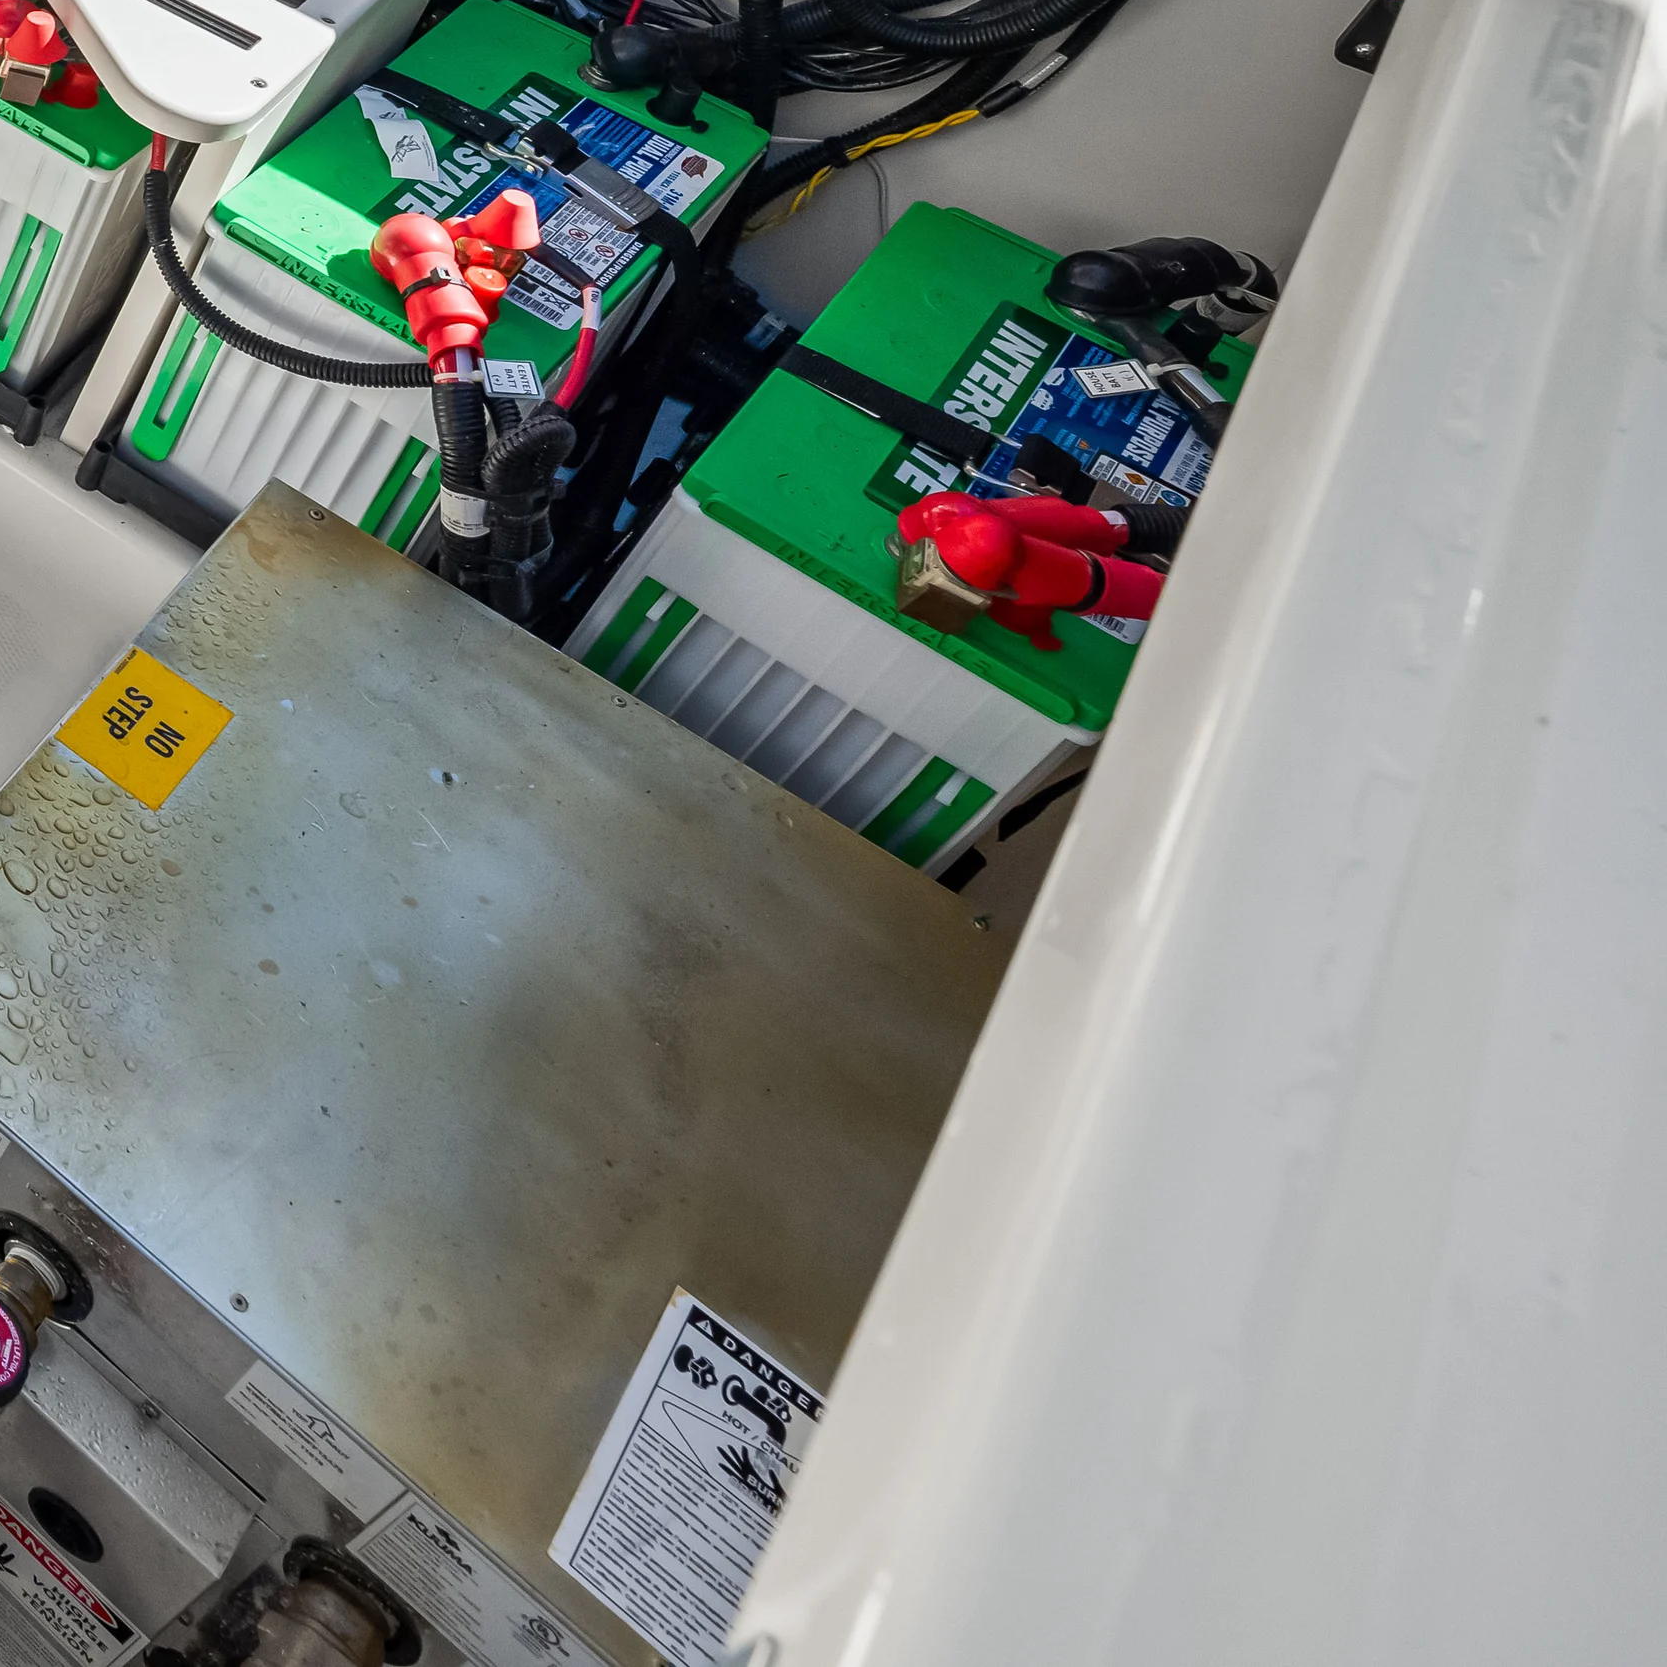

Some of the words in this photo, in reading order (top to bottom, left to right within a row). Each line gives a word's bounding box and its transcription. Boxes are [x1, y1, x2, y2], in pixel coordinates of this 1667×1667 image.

[393, 85, 549, 229] INTSTATE
[636, 134, 669, 166] DUAL
[595, 240, 642, 288] DANGER/POISON
[504, 367, 518, 390] BATT
[515, 363, 532, 394] CENTER
[1085, 370, 1106, 395] HOUSE
[1102, 370, 1120, 390] BATT
[892, 318, 1045, 504] INTERSTE
[1121, 407, 1174, 469] PURPOSE
[102, 685, 152, 736] STEP
[142, 720, 184, 762] NO
[719, 1409, 751, 1436] HOT
[406, 1512, 476, 1576] KUUMA
[18, 1587, 95, 1664] TENSION
[30, 1574, 109, 1652] VOLTAGE
[31, 1592, 92, 1651] HAUTE
[49, 1585, 98, 1631] HIGH
